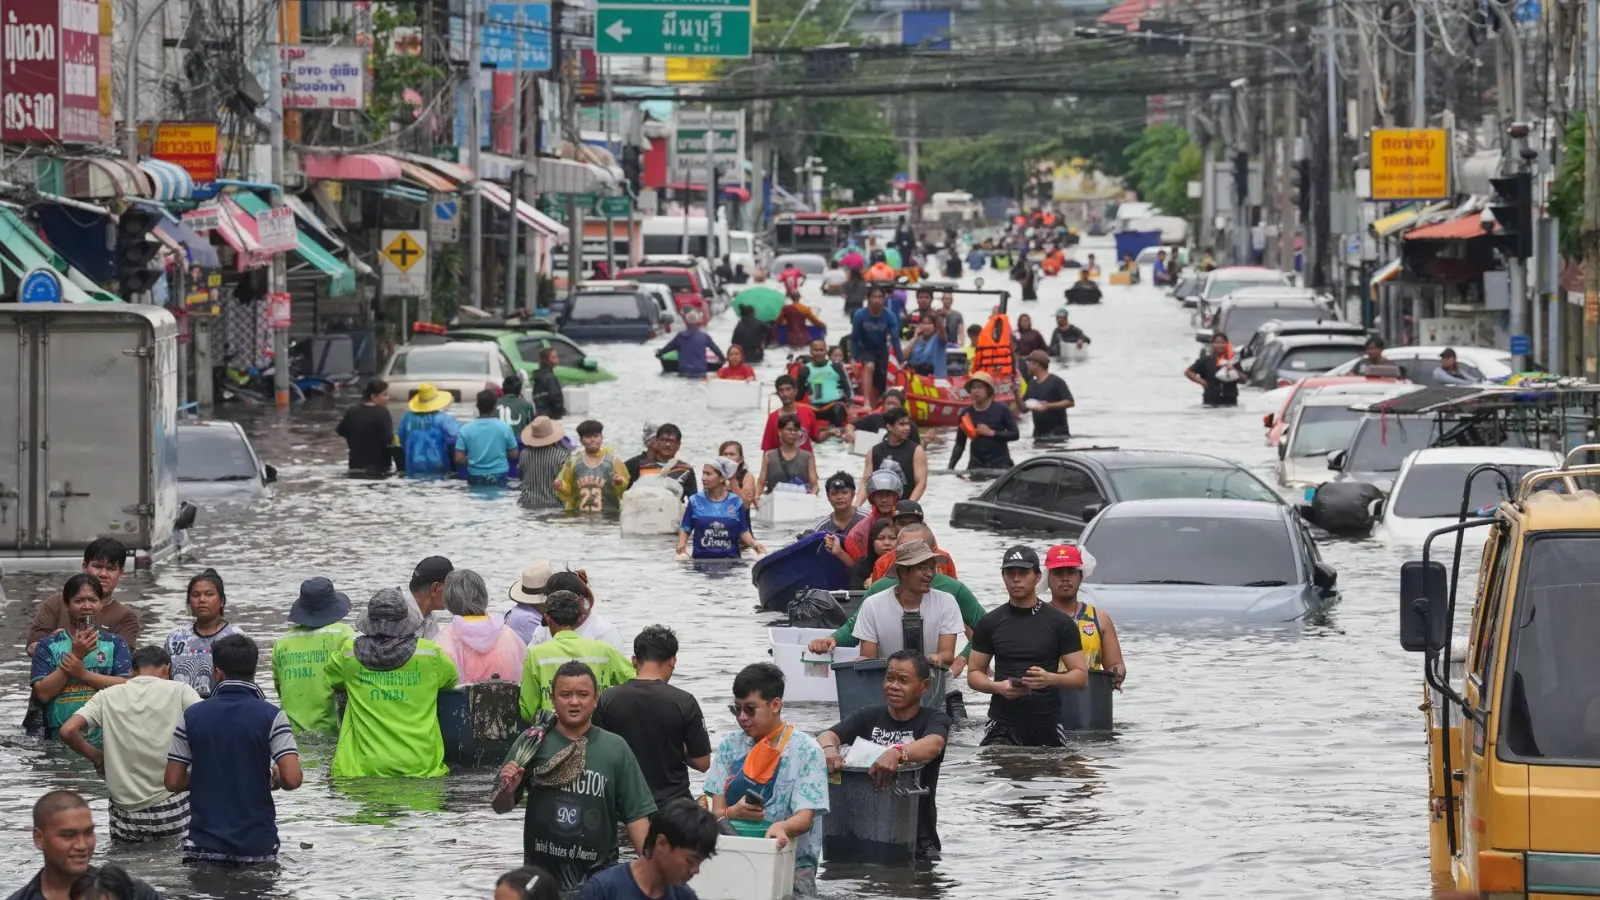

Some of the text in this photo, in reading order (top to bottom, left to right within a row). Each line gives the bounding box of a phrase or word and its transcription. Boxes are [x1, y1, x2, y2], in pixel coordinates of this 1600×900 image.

[662, 11, 722, 43] มีนบุรี
[5, 10, 55, 75] มุ้งลวด
[664, 42, 720, 53] Min Buri
[5, 93, 55, 130] กระจก
[580, 487, 603, 511] 23
[701, 537, 731, 549] Chang
[171, 641, 186, 655] 30
[284, 666, 316, 681] กทม.
[370, 688, 408, 702] กทม.
[871, 726, 896, 740] Enjoy
[557, 807, 577, 825] DC
[549, 840, 567, 857] States
[569, 844, 577, 860] of
